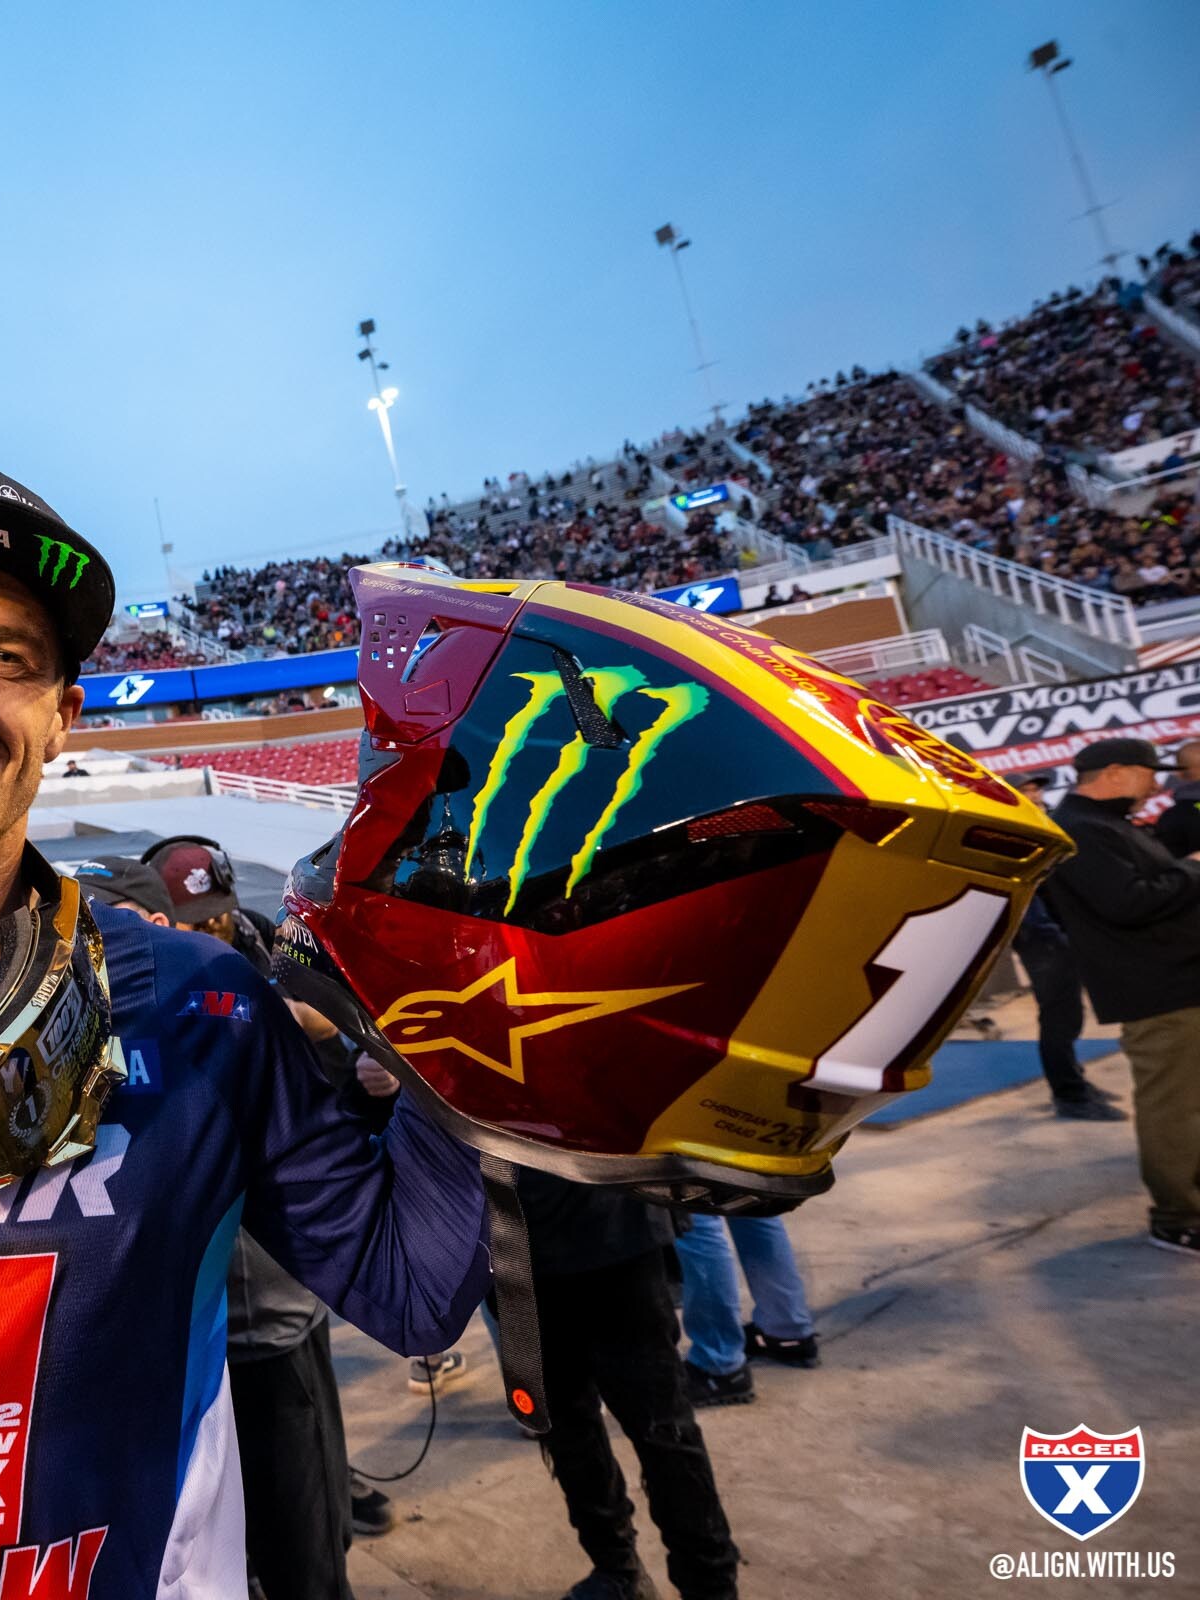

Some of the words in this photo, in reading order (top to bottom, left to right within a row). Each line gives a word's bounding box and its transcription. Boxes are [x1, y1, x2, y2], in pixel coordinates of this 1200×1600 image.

[719, 632, 832, 703] Champion
[176, 991, 252, 1022] AMA
[813, 887, 1009, 1091] 1
